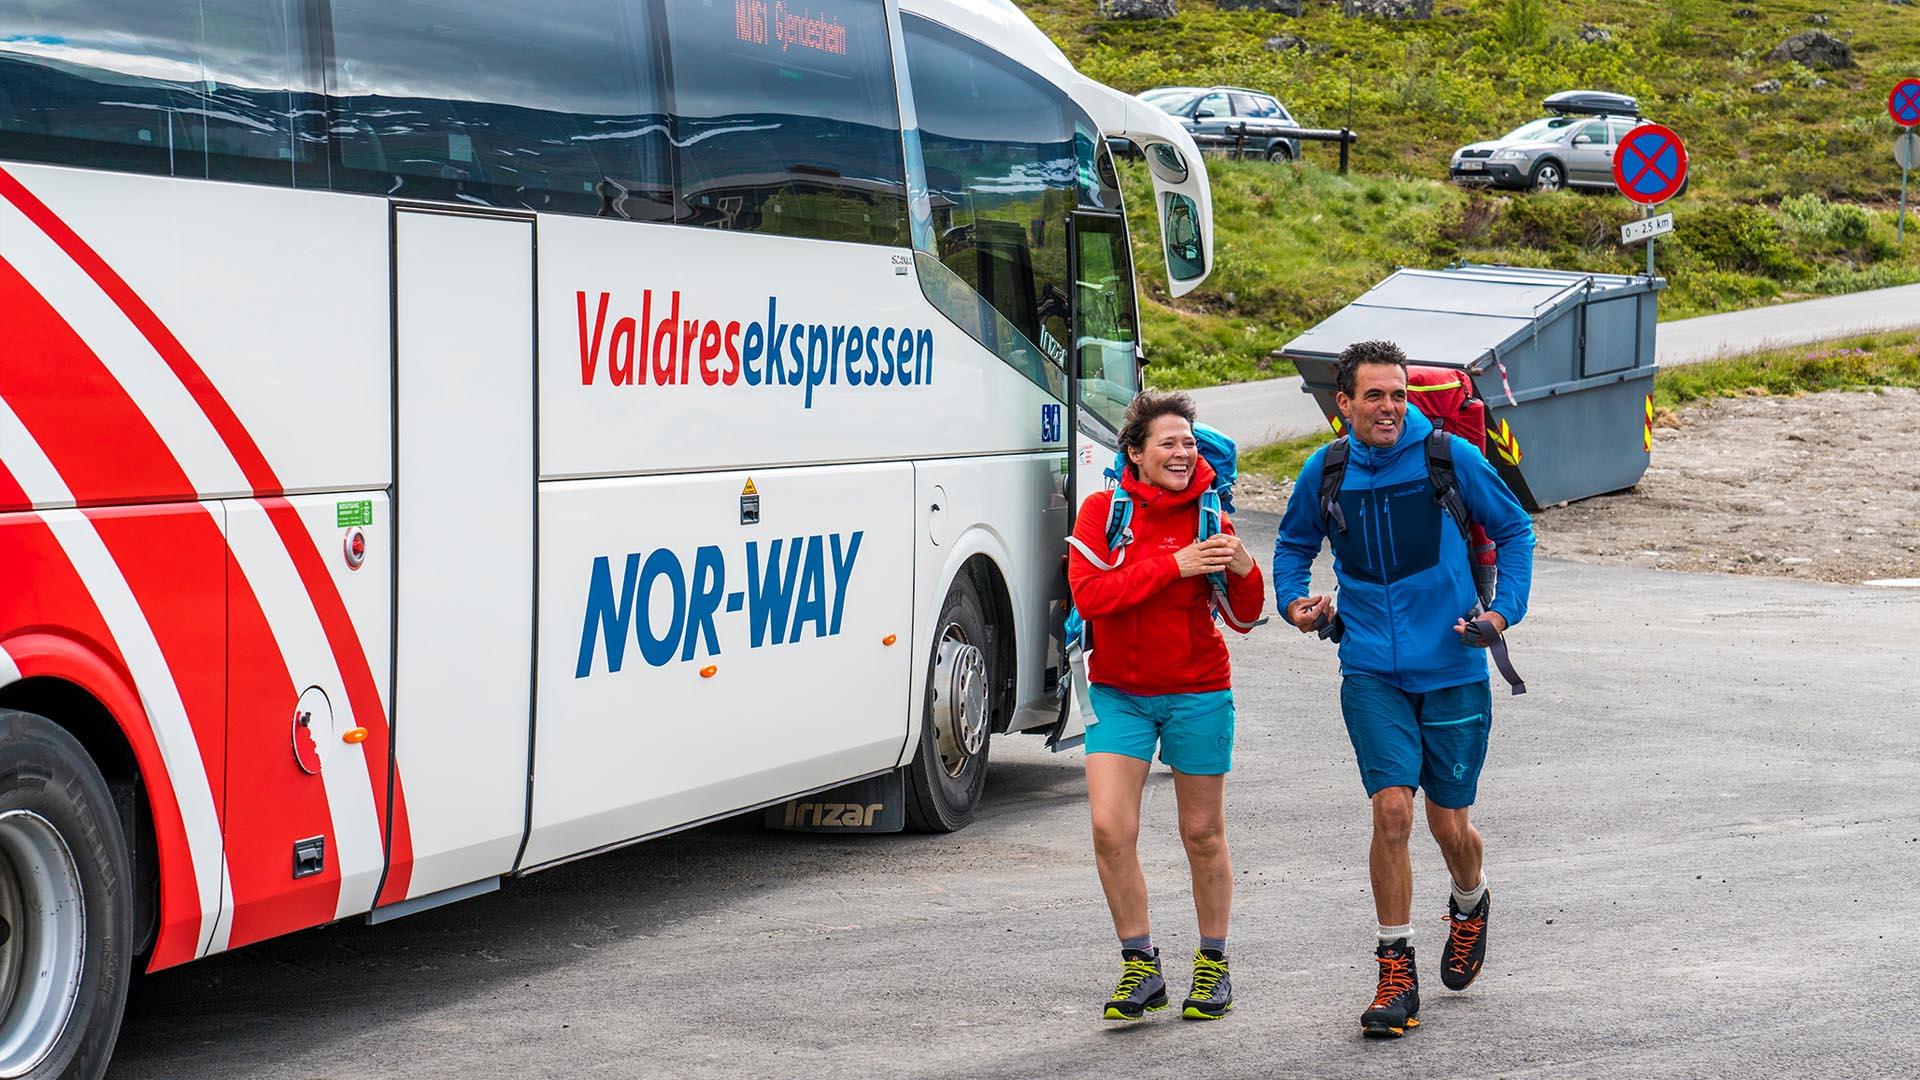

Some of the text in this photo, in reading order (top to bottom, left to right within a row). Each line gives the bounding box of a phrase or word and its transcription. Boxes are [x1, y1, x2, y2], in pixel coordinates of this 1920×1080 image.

[775, 1, 847, 55] Gjendesheim
[1625, 227, 1631, 238] 0
[1656, 218, 1669, 230] km
[576, 289, 934, 409] Valdresekspressen
[575, 530, 864, 679] NOR-WAY
